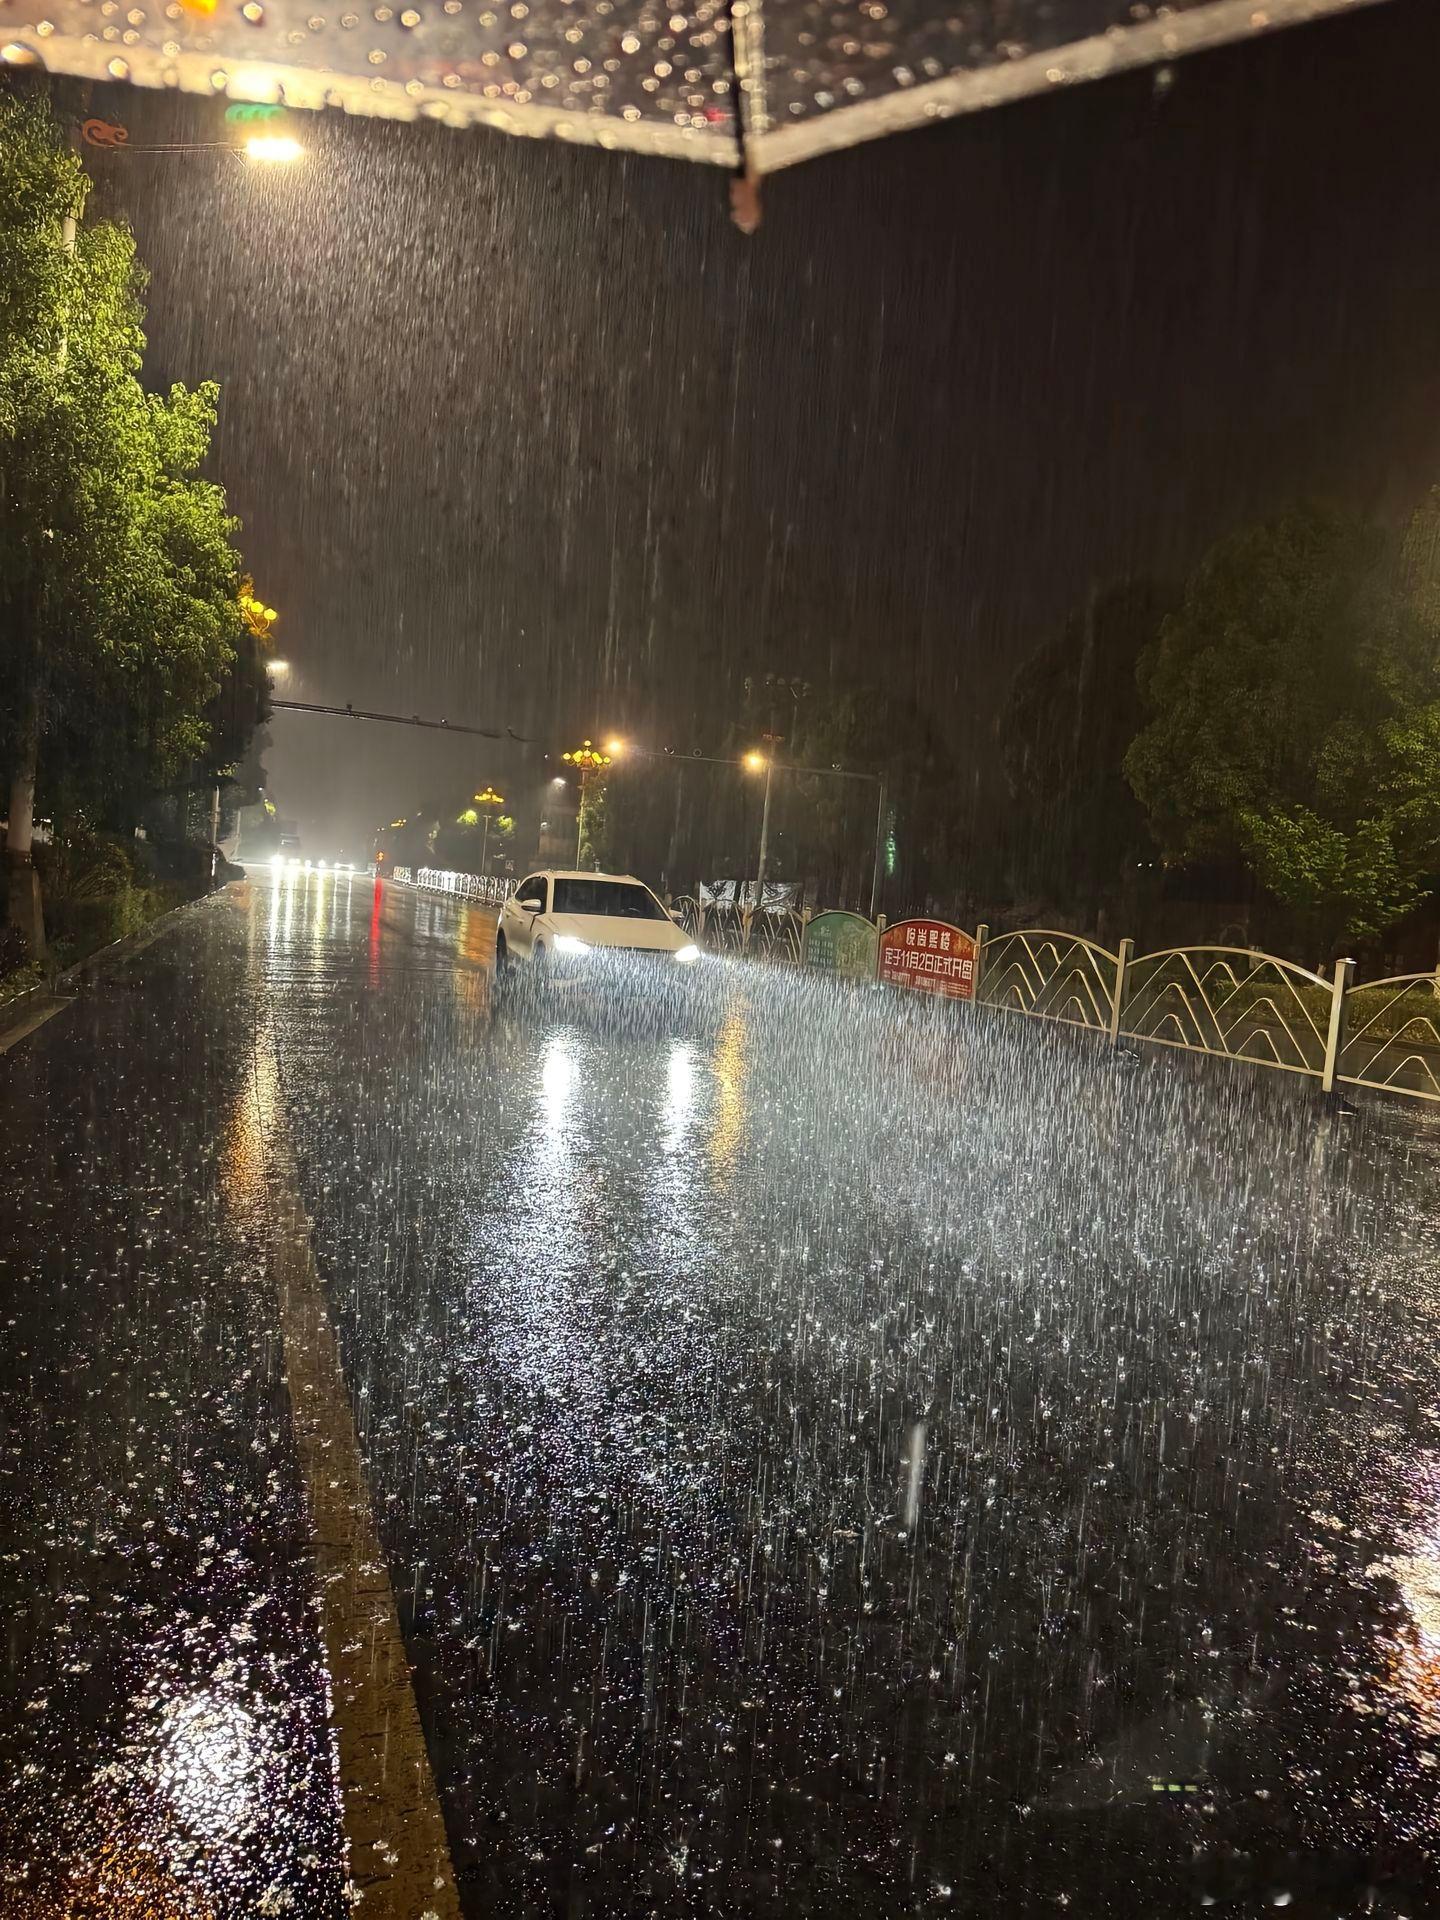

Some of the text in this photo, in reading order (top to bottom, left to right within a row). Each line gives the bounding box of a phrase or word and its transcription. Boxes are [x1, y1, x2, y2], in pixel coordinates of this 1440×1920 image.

[885, 947, 973, 980] 定于11月2日正式开盘
